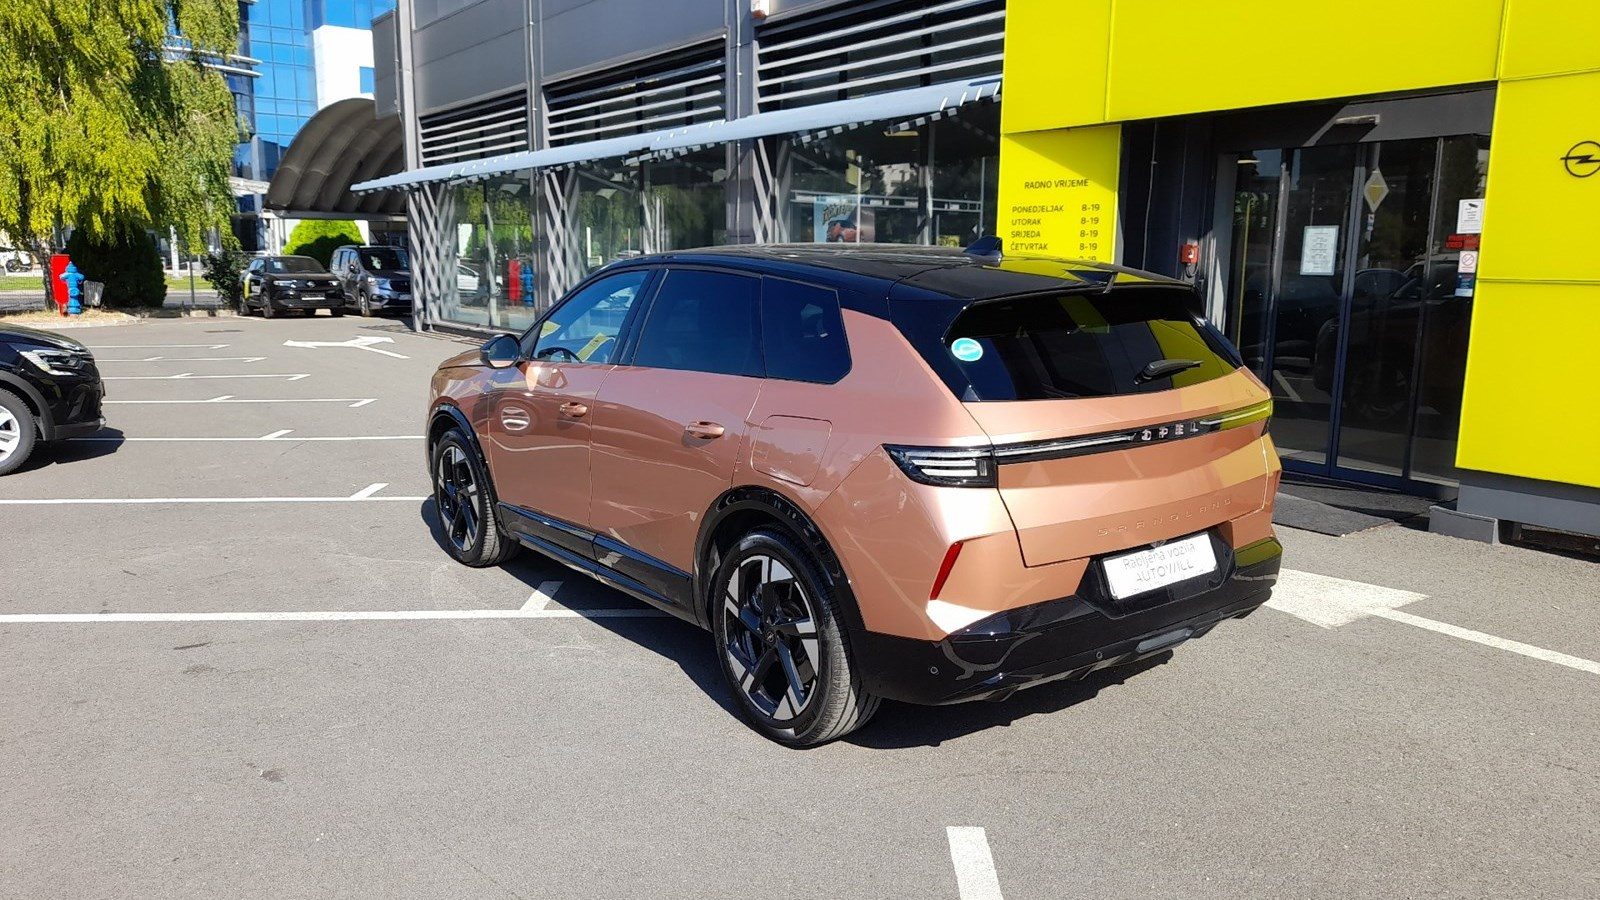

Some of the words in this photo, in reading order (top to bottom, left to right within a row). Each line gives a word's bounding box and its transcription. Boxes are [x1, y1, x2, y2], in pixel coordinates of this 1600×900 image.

[1024, 181, 1052, 189] RADNO
[1054, 179, 1089, 187] VRIJEME
[1012, 205, 1064, 213] PONEDJELJAK
[1081, 203, 1100, 211] 8-19
[1011, 218, 1041, 226] UTORAK
[1010, 230, 1041, 238] SRIJEDA
[1079, 229, 1098, 237] 8-19
[1010, 241, 1048, 250] ČETVRTAK
[1141, 421, 1199, 441] OPEL
[1122, 549, 1166, 571] Rabljena
[1166, 542, 1196, 559] vozila
